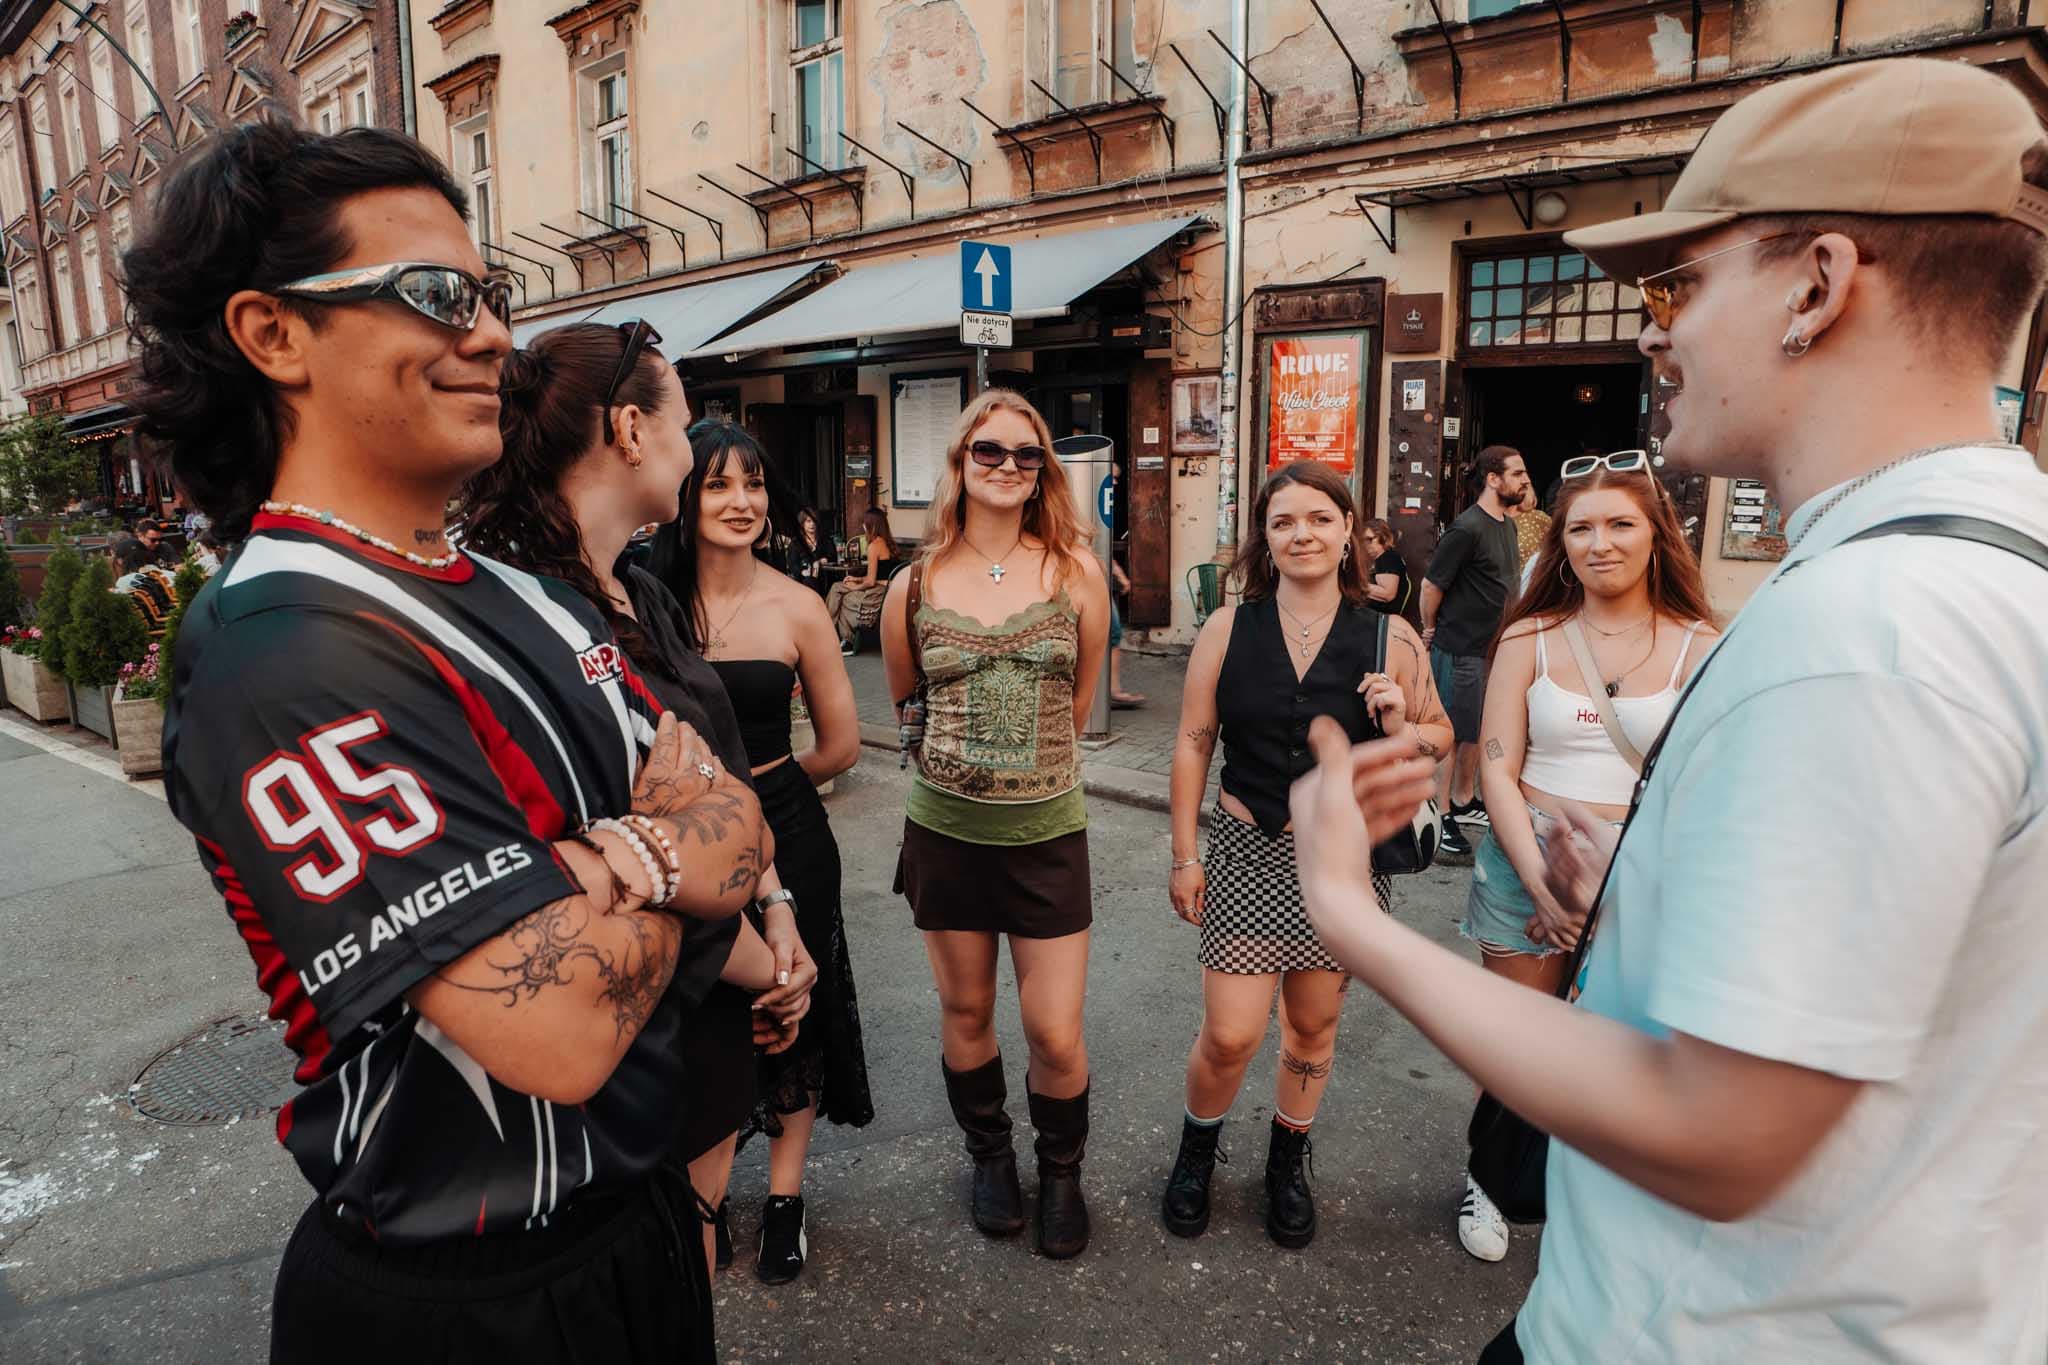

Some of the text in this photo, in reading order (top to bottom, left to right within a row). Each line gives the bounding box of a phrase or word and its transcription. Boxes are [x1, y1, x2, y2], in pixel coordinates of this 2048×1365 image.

[966, 315, 1009, 328] Nie dotyczy
[241, 709, 446, 904] 95
[299, 842, 533, 996] LOS ANGELES
